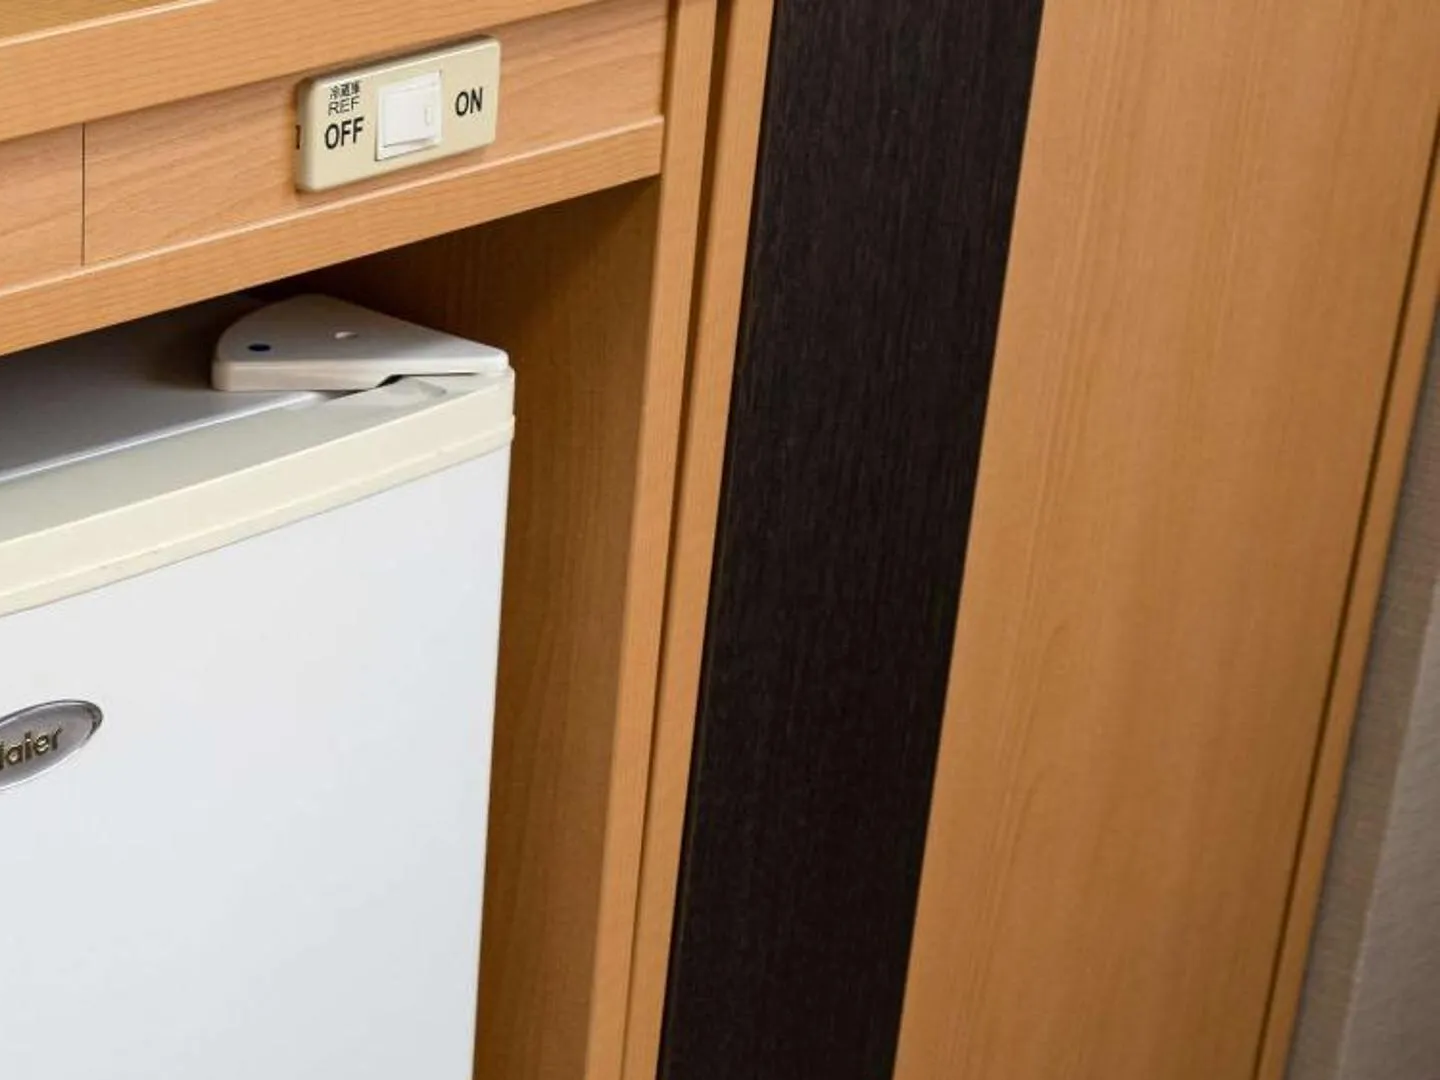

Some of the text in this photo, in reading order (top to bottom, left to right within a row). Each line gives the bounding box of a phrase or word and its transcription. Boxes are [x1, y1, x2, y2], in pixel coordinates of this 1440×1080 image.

[328, 97, 360, 116] REF
[455, 87, 483, 117] ON
[324, 117, 364, 150] OFF
